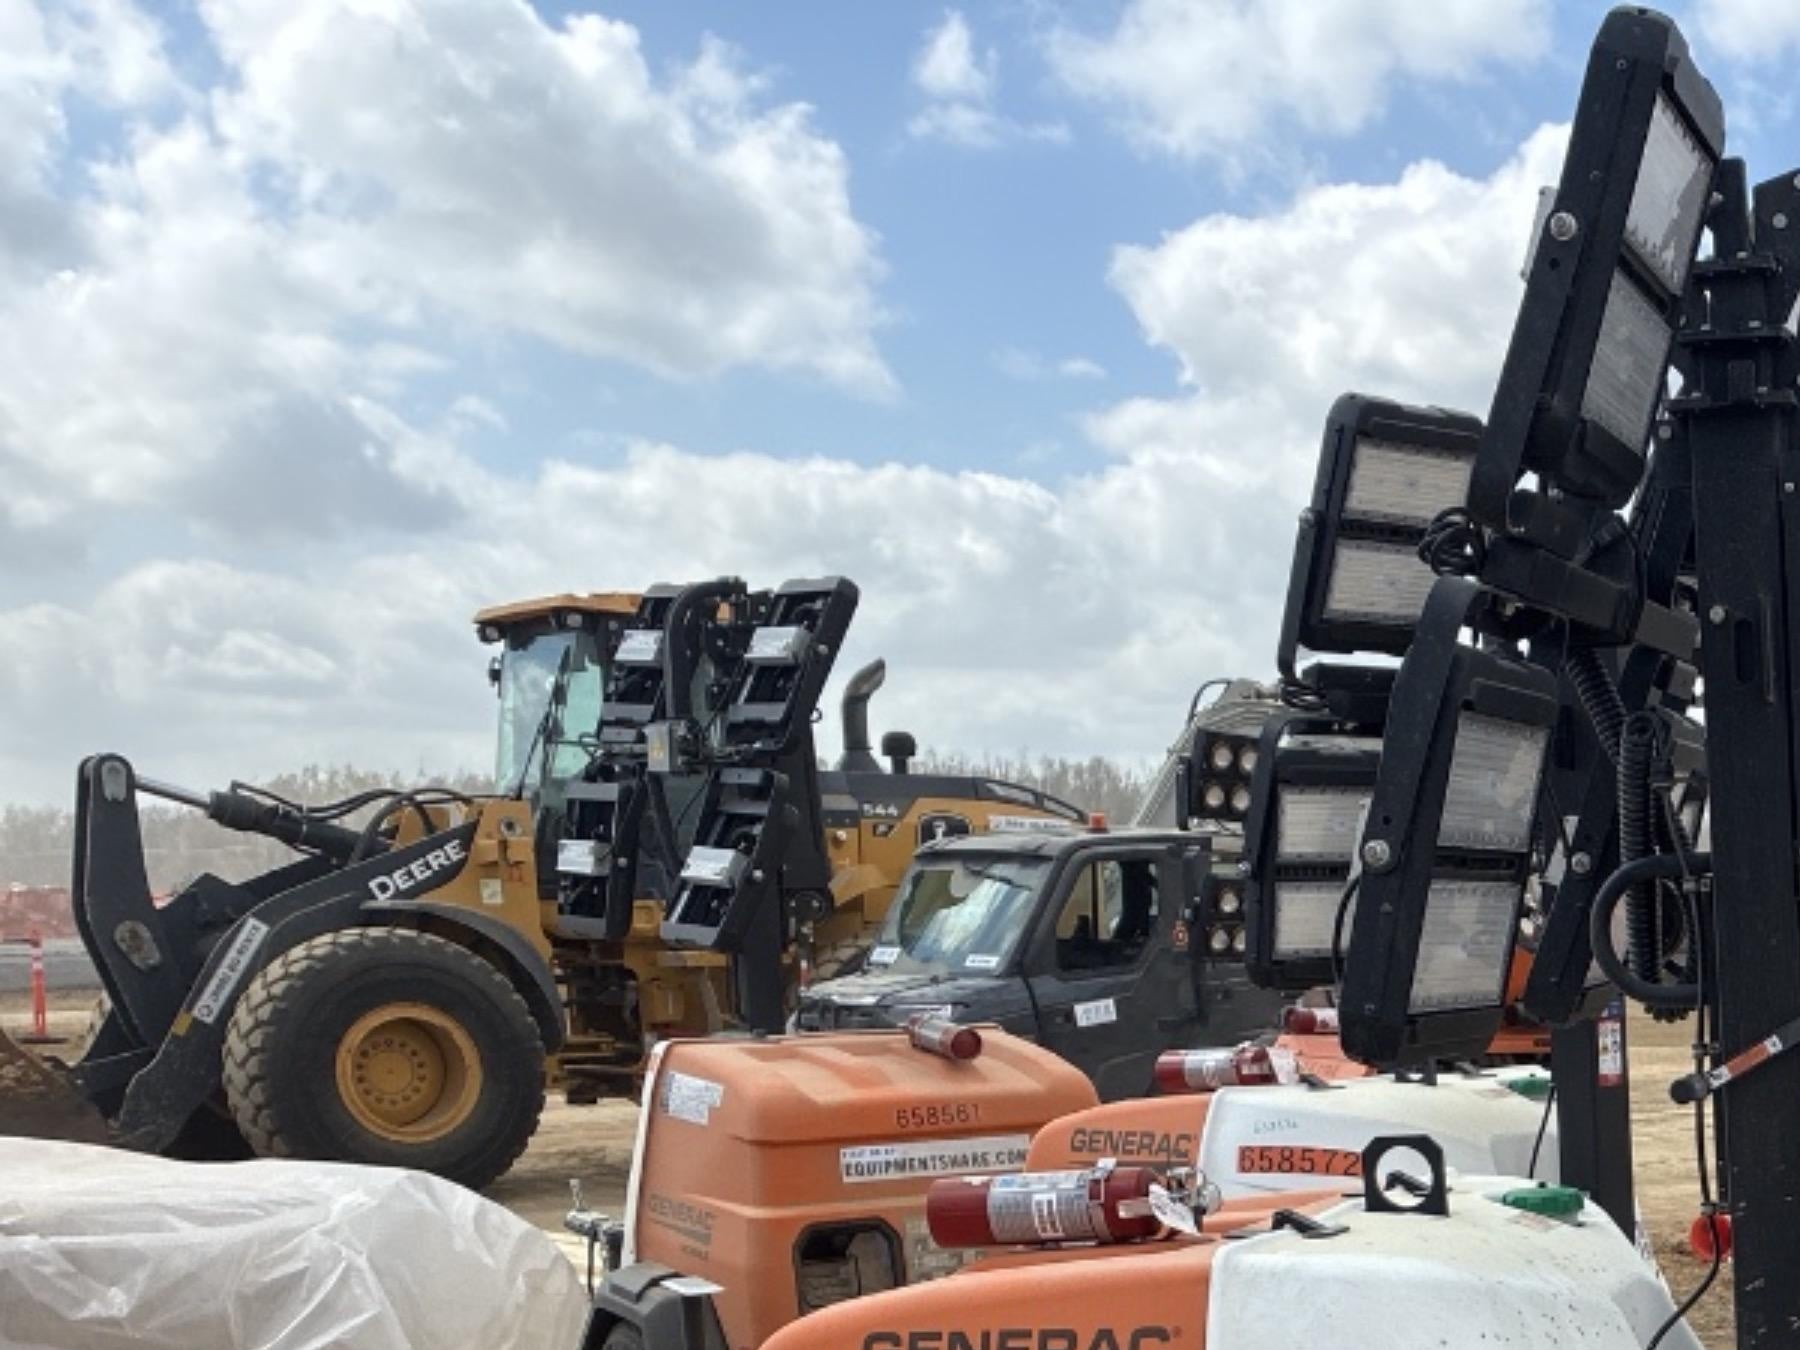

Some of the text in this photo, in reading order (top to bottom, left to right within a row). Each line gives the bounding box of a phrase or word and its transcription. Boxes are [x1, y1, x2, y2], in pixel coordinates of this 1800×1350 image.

[863, 803, 898, 816] 544
[368, 840, 466, 900] DEERE
[896, 1103, 981, 1129] 658561
[1070, 1128, 1191, 1158] GENERAC
[1240, 1146, 1360, 1176] 658572
